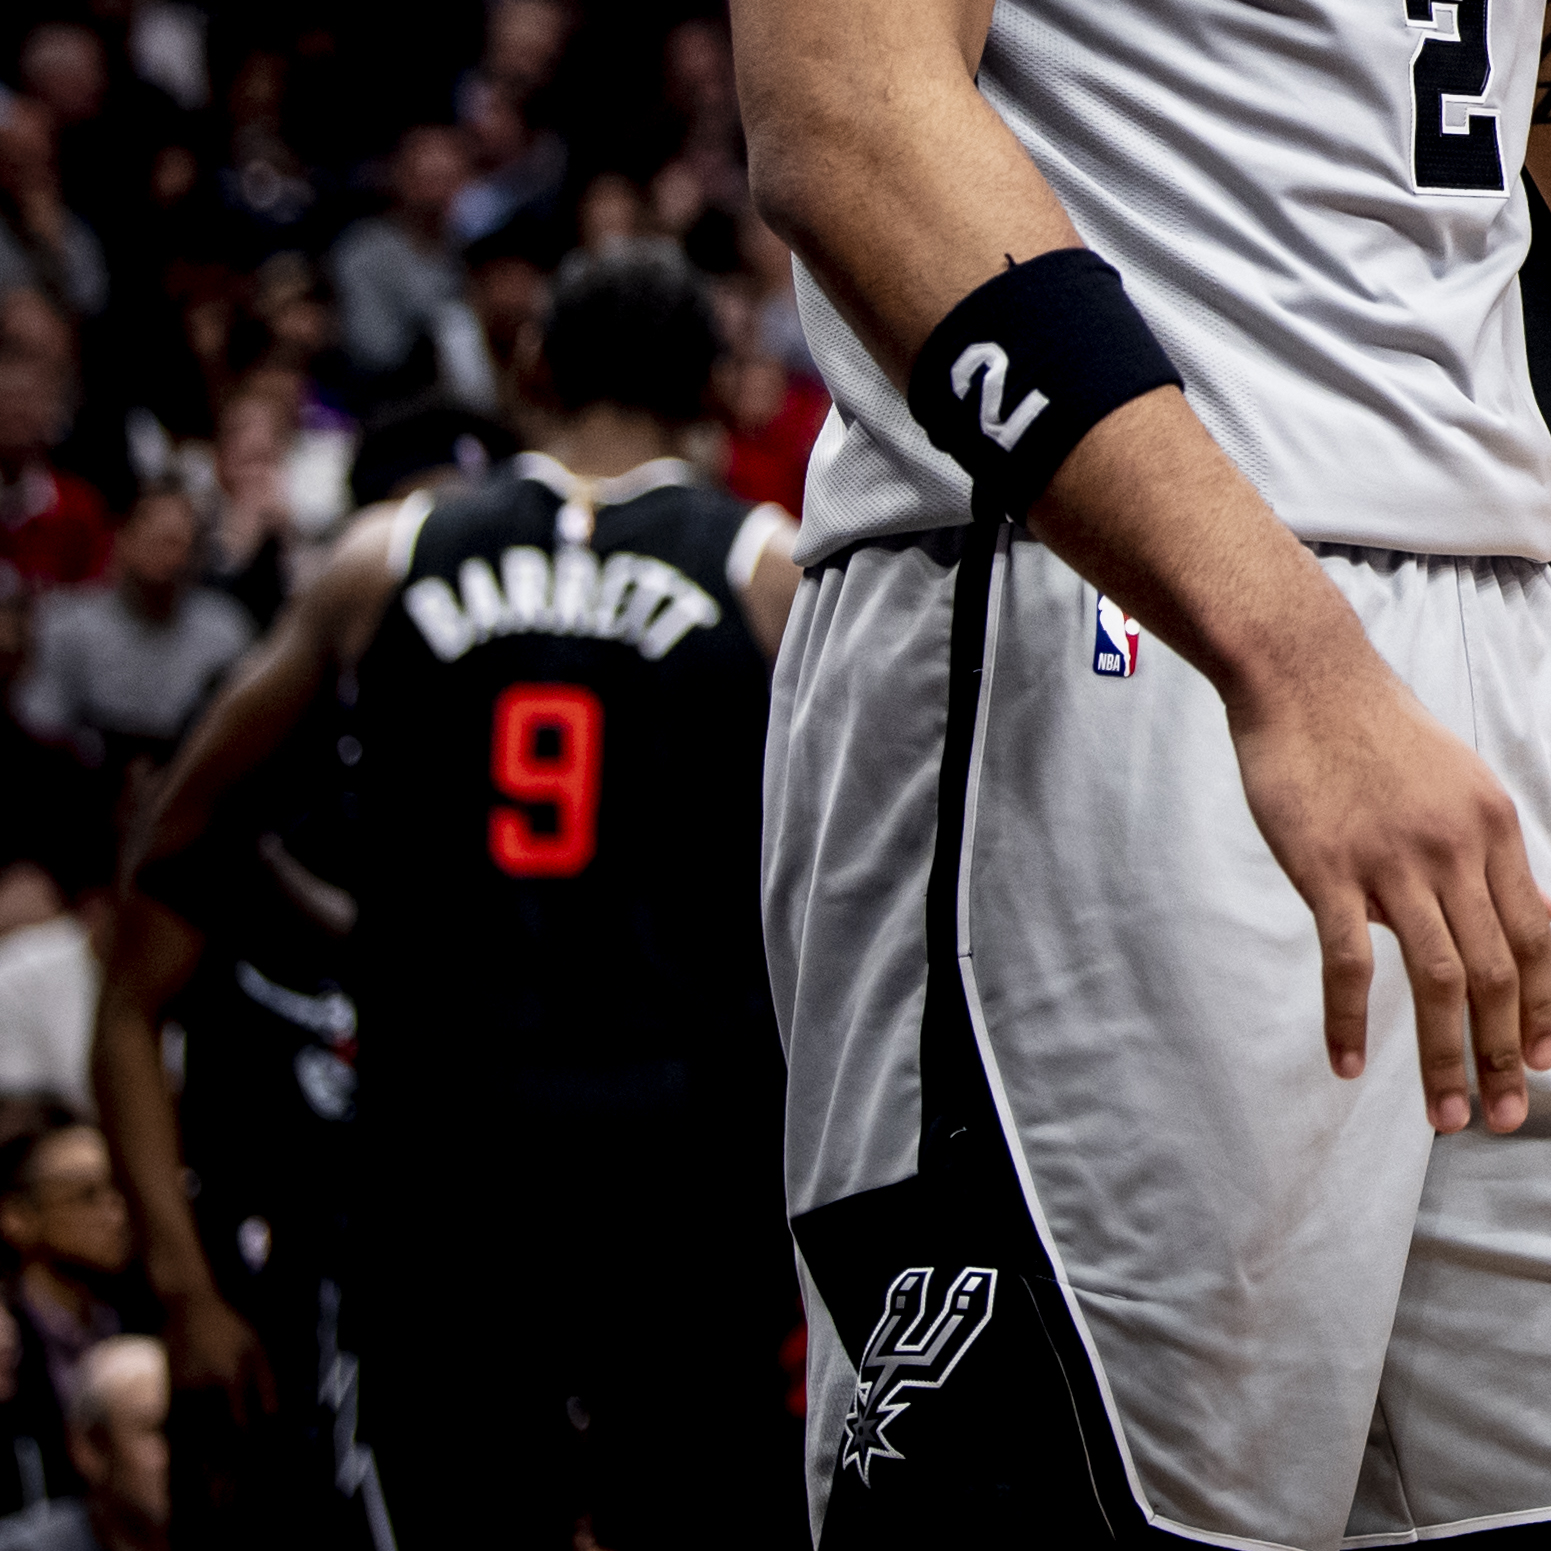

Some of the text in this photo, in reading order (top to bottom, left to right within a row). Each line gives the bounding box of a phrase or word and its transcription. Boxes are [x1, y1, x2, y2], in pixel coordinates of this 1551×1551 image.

[951, 342, 1049, 451] 2
[1098, 653, 1121, 672] NBA
[489, 681, 605, 878] 9
